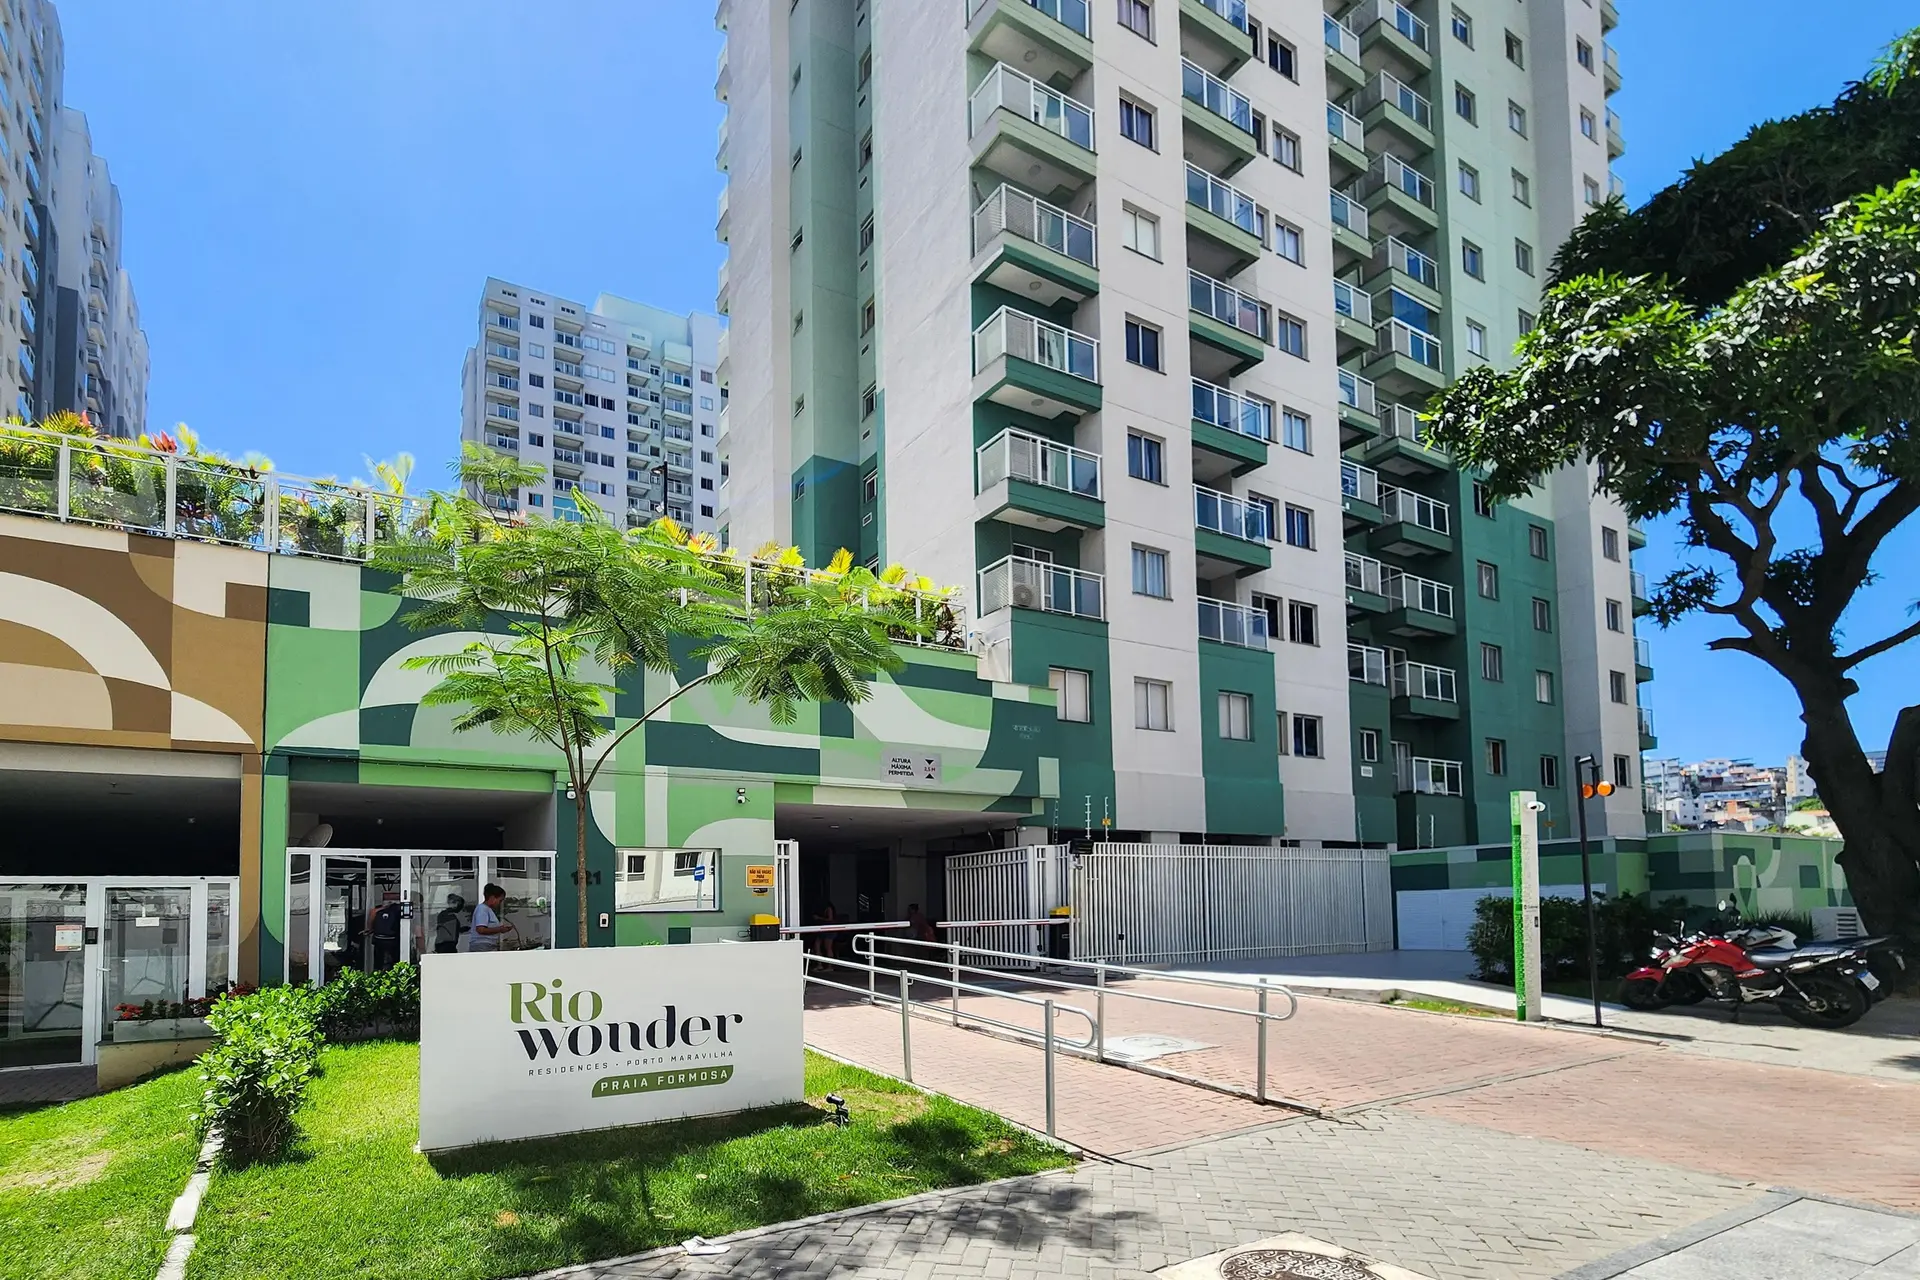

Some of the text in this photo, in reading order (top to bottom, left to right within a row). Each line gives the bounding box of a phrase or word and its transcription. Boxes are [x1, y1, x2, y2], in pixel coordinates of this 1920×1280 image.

[506, 979, 602, 1023] Rio
[514, 1005, 743, 1060] wonder
[528, 1050, 733, 1076] RESIDENCES PORTO MARAVILHA
[600, 1070, 728, 1092] PRAIA FORMOSA
